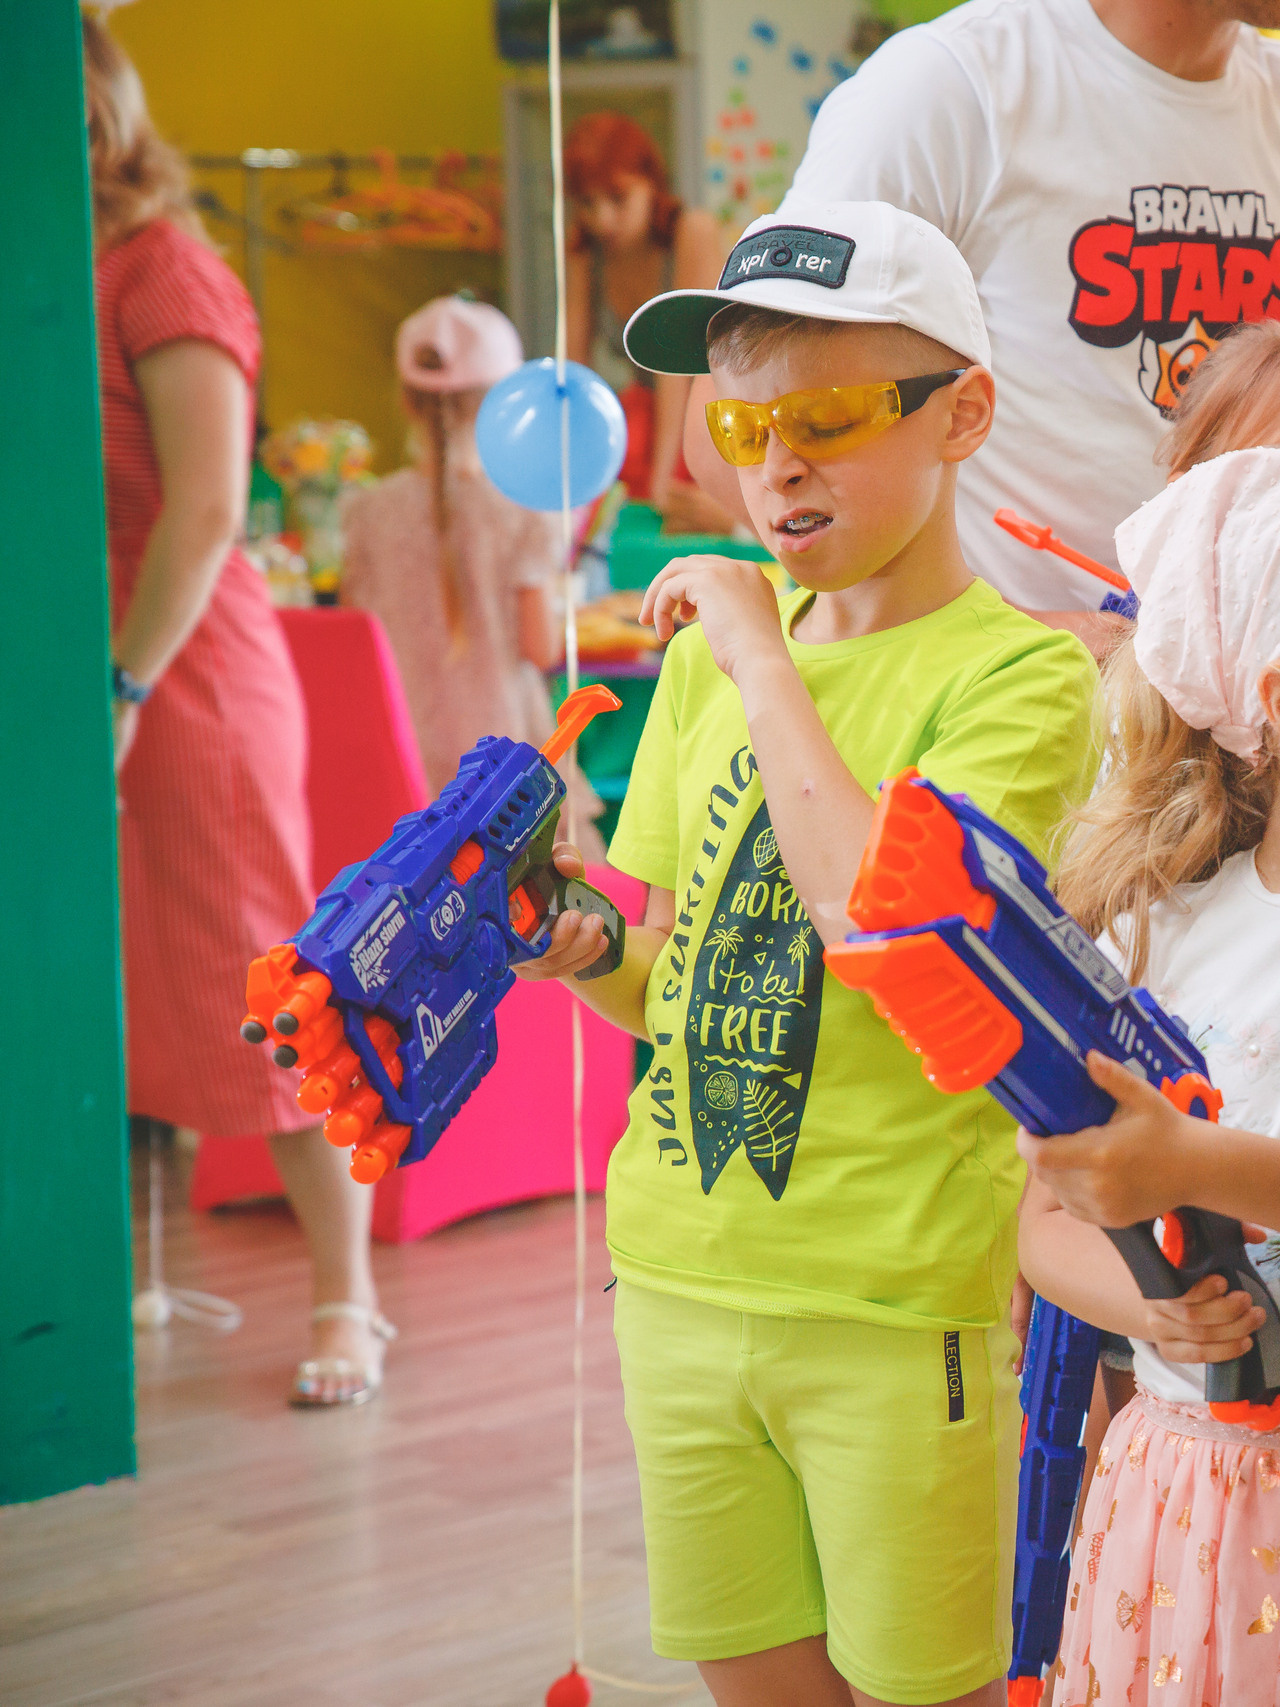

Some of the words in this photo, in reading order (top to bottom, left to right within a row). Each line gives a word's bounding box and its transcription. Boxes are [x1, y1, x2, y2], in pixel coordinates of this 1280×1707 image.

[1131, 184, 1275, 241] BRAWL
[357, 937, 385, 971] Blaze
[380, 911, 406, 946] storm
[719, 958, 754, 994] to
[762, 960, 794, 996] be
[700, 1002, 792, 1056] FREE
